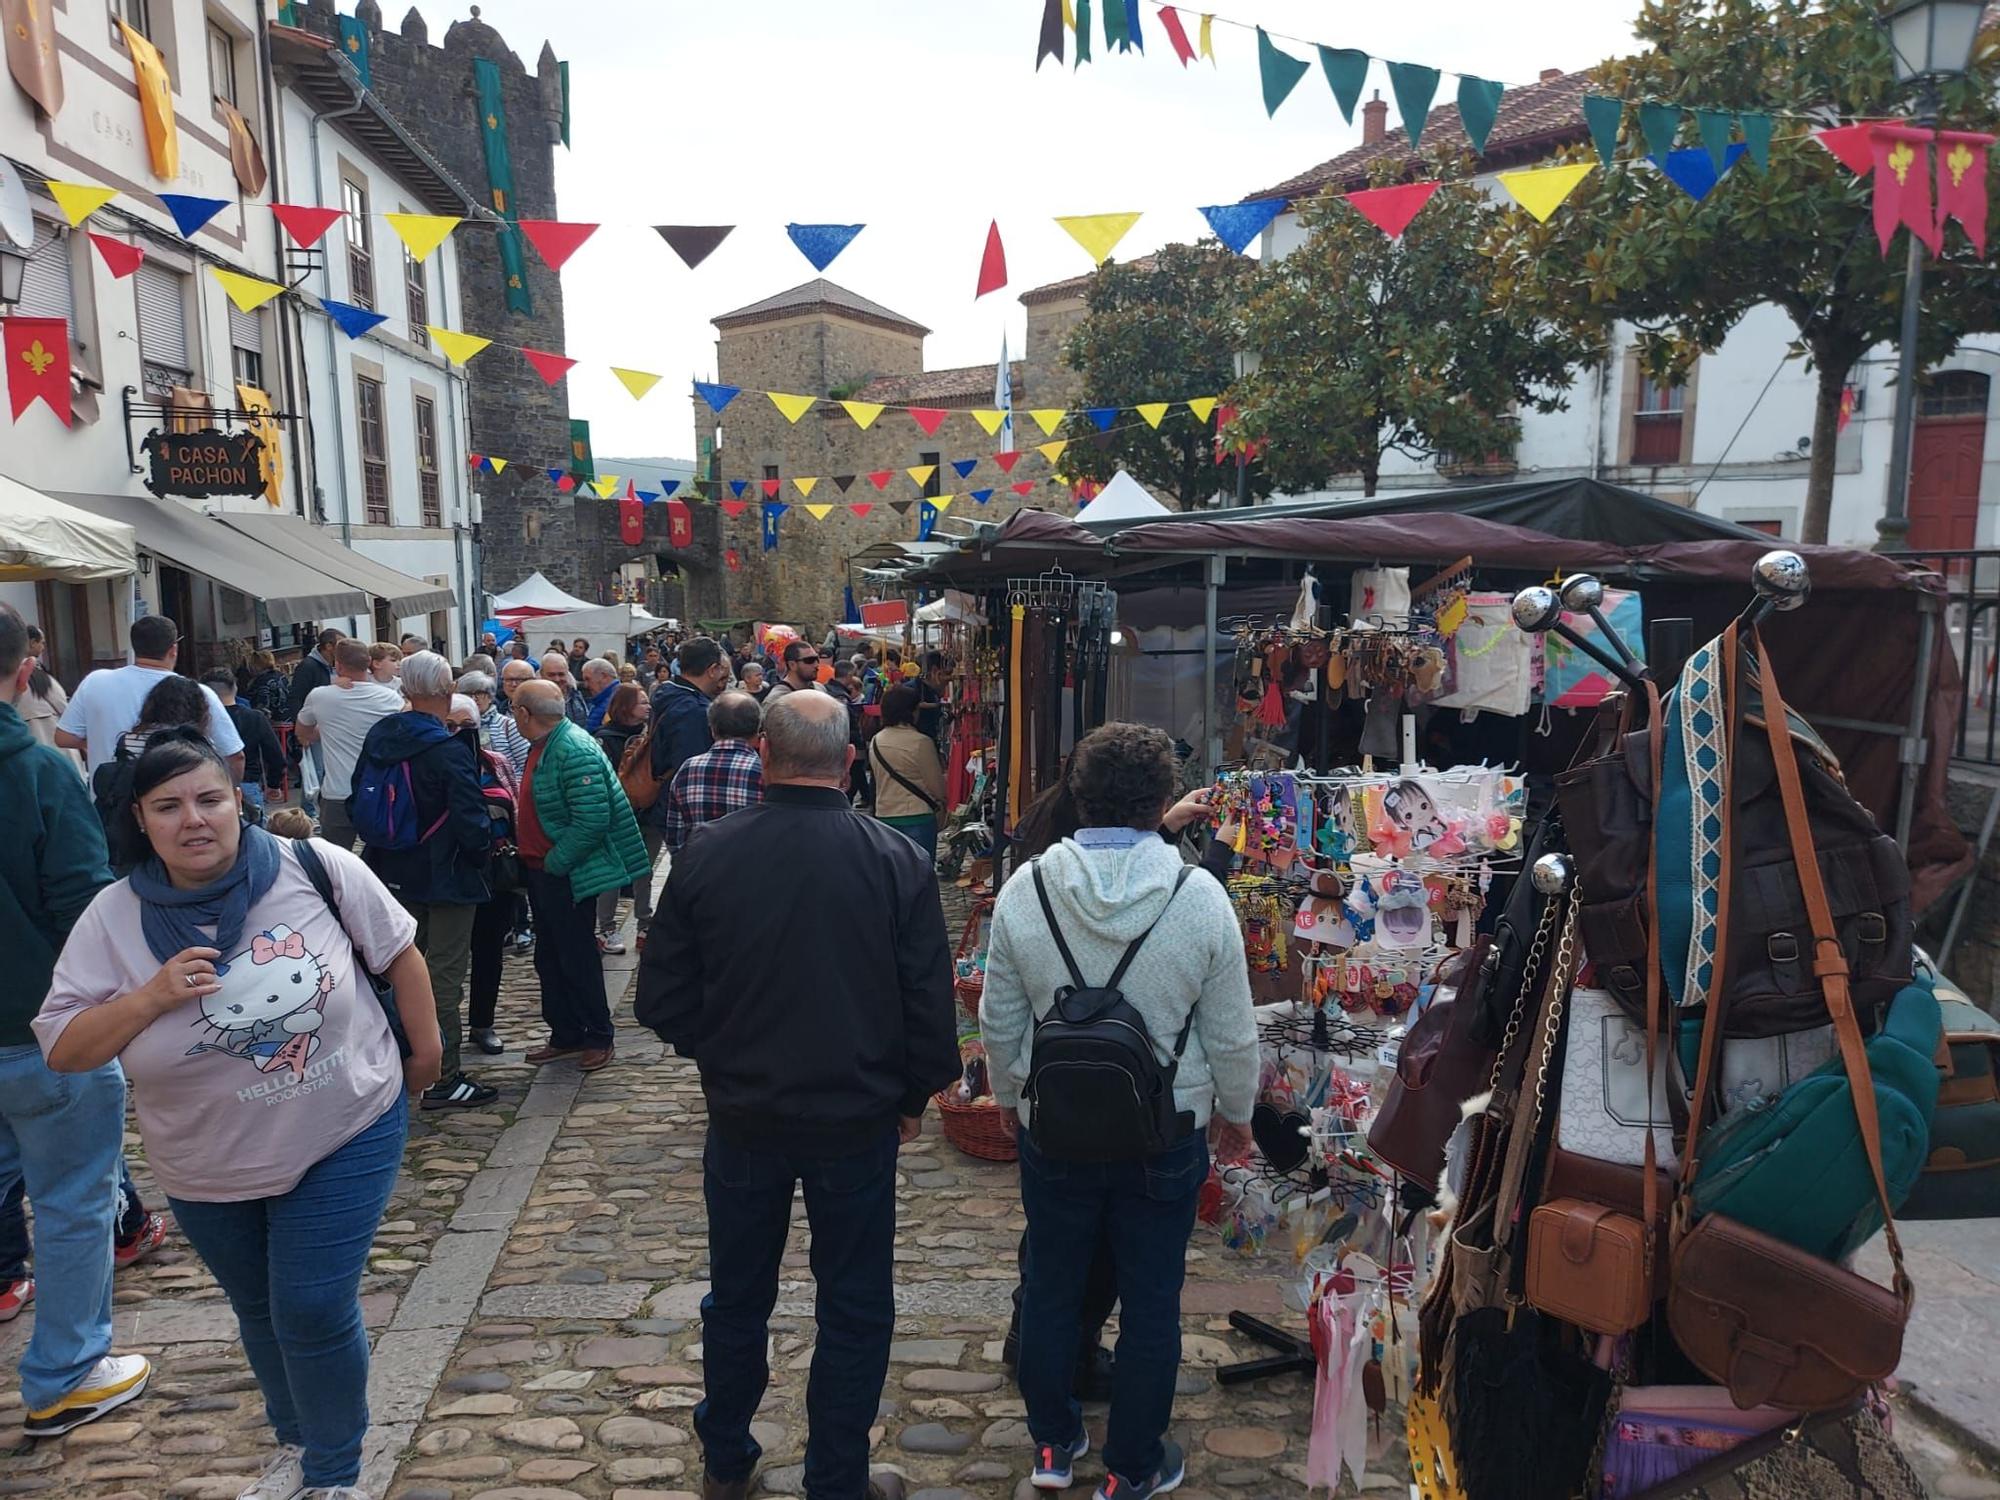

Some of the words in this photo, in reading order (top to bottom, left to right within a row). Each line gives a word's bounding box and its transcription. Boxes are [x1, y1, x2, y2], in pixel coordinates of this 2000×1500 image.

[179, 446, 230, 464] CASA
[170, 466, 246, 484] PACHON
[1300, 913, 1311, 926] 1€
[236, 1071, 299, 1102] HELLO
[303, 1046, 345, 1081] KITTY
